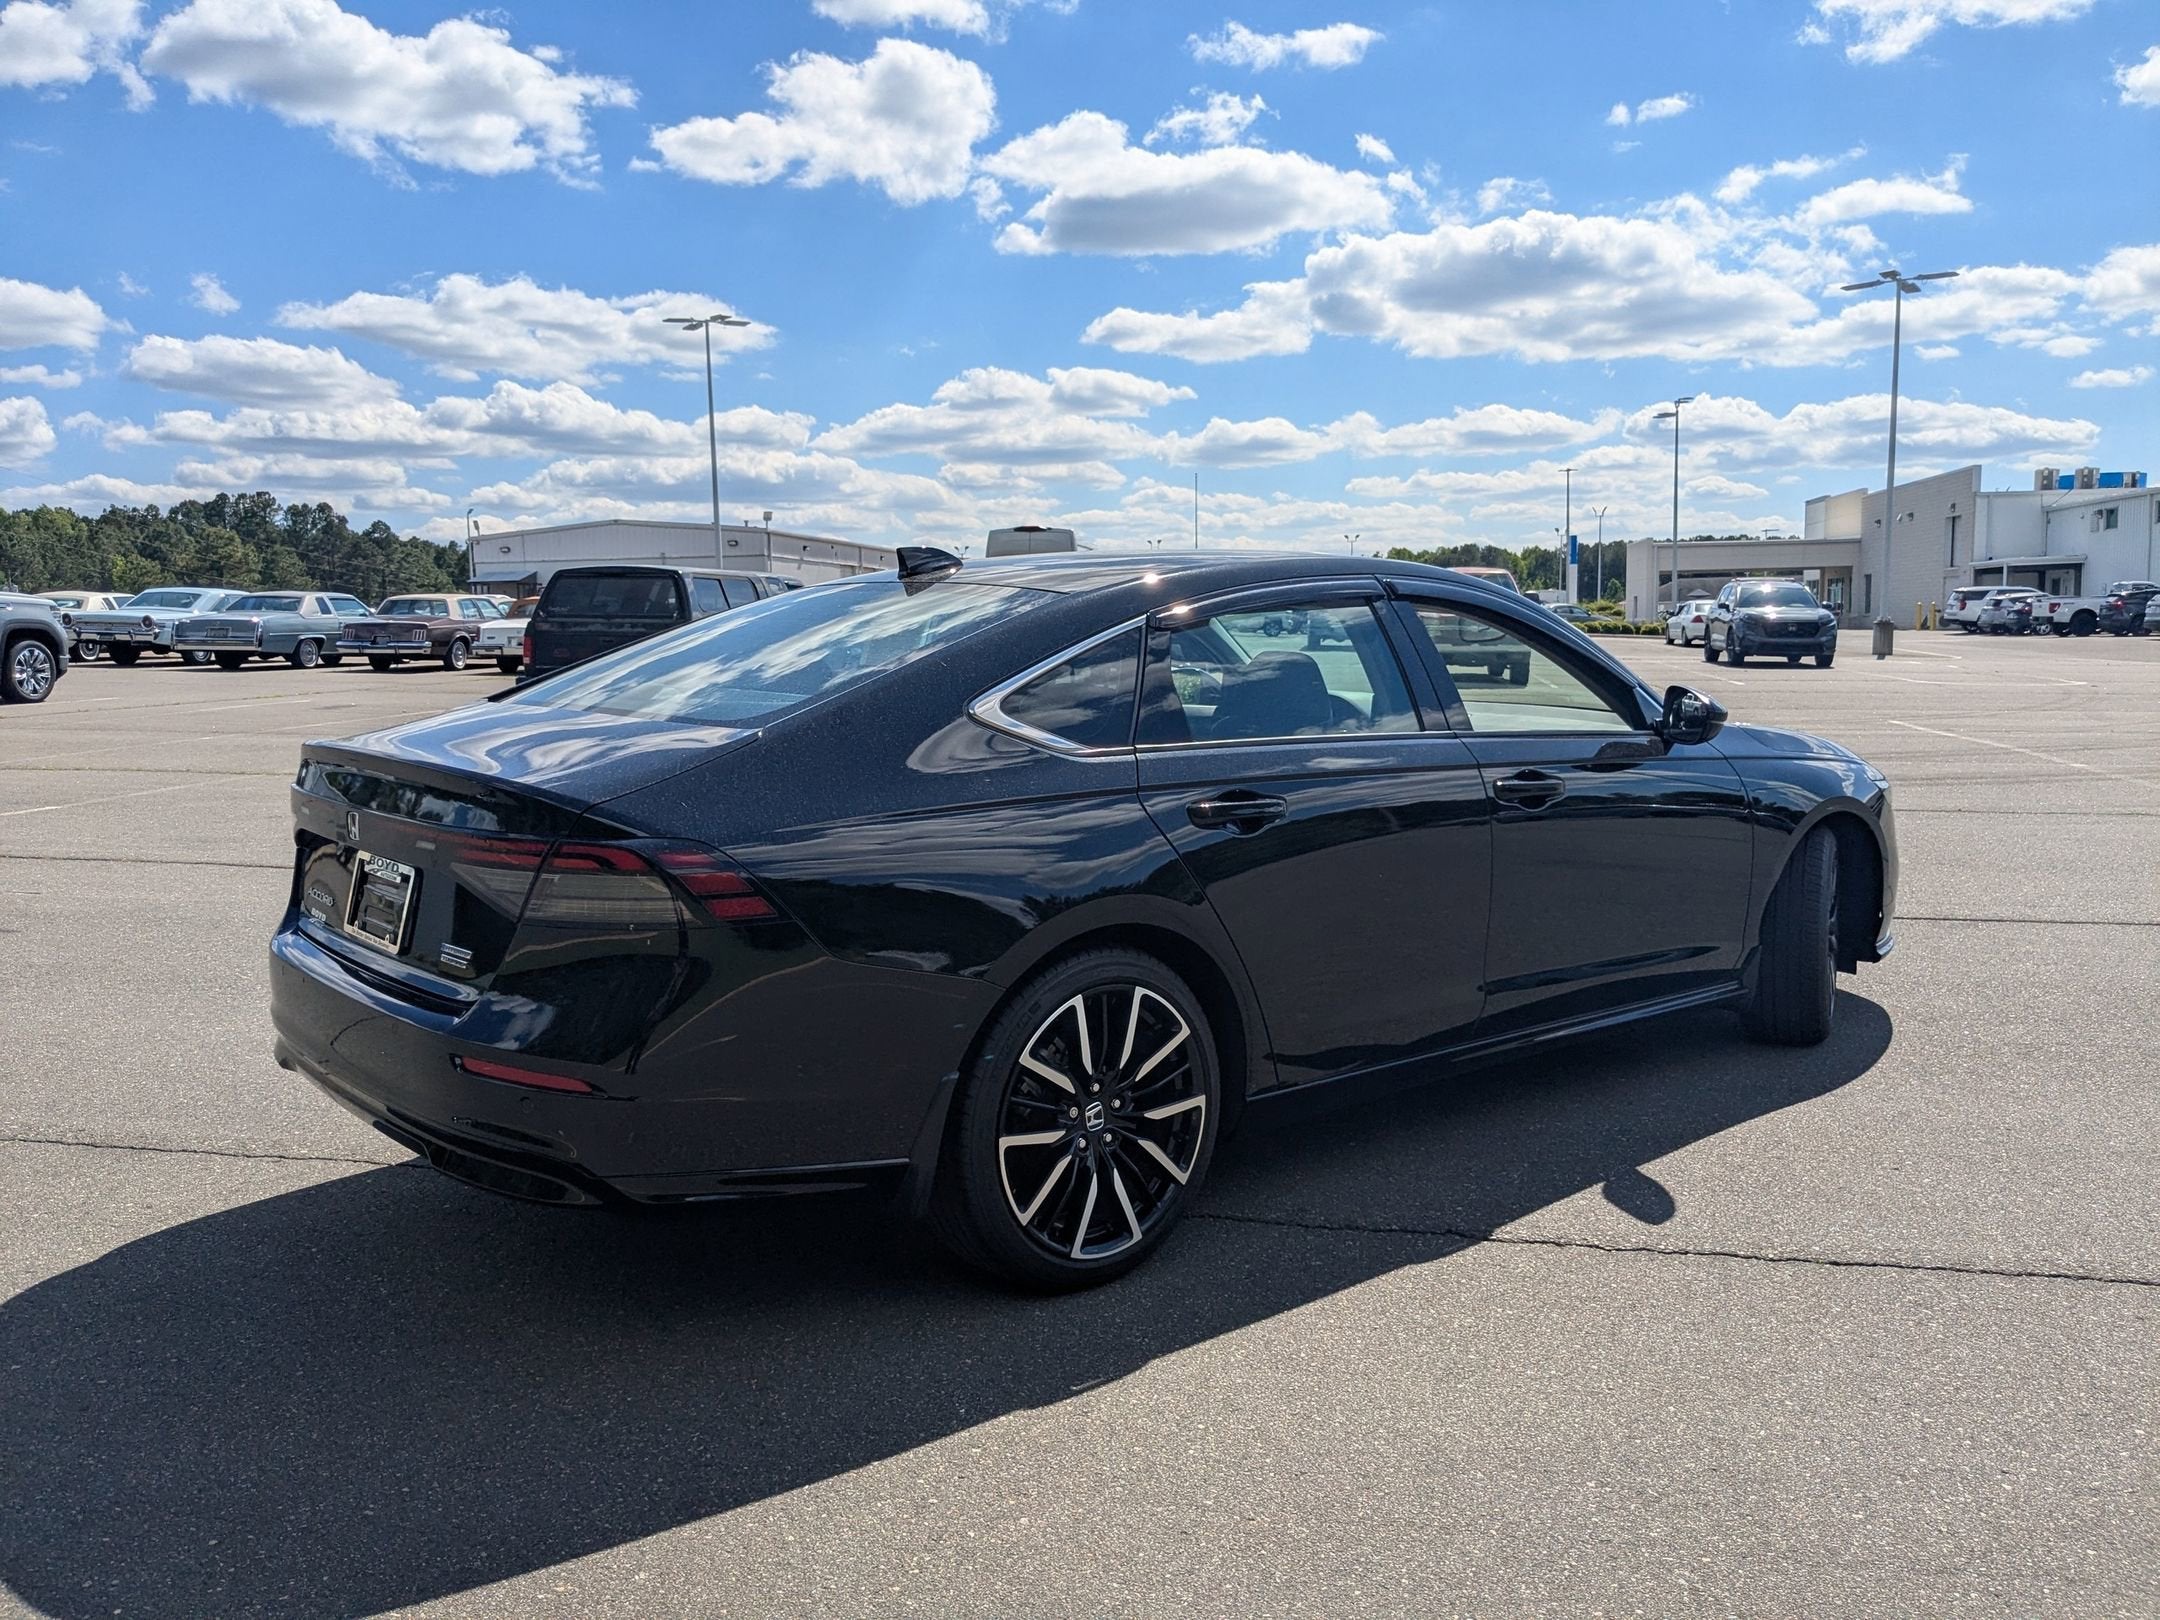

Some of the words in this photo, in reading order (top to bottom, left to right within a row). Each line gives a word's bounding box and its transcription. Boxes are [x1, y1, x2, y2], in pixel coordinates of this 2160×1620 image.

[368, 855, 400, 873] BOYD
[308, 887, 334, 906] ACCORD
[311, 907, 326, 921] BOYD
